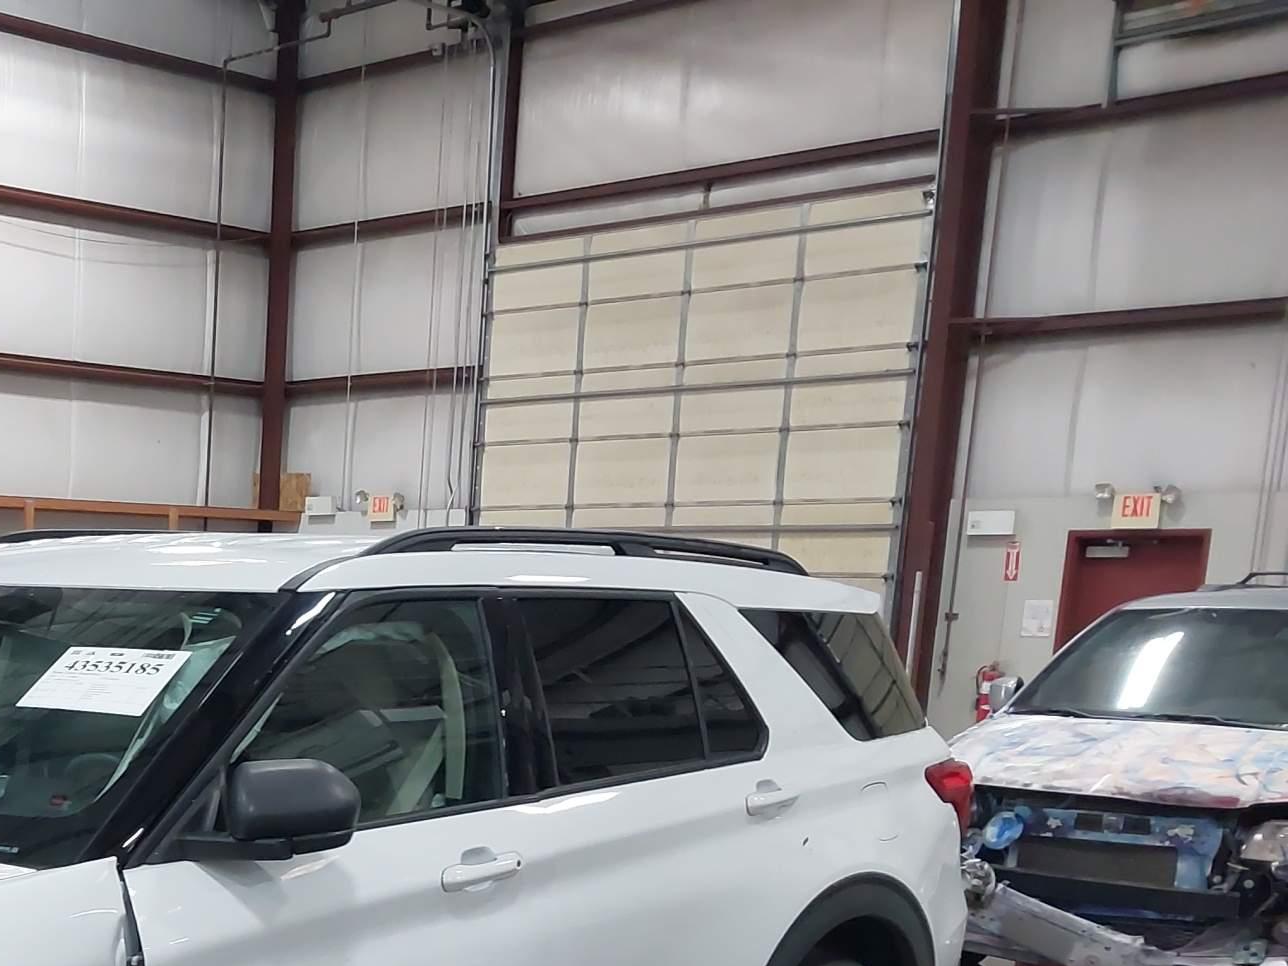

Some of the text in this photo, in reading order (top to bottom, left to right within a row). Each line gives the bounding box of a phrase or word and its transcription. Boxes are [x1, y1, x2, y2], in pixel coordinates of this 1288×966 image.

[373, 496, 389, 512] EXIT
[1121, 495, 1154, 517] EXIT
[64, 659, 165, 676] 43535185
